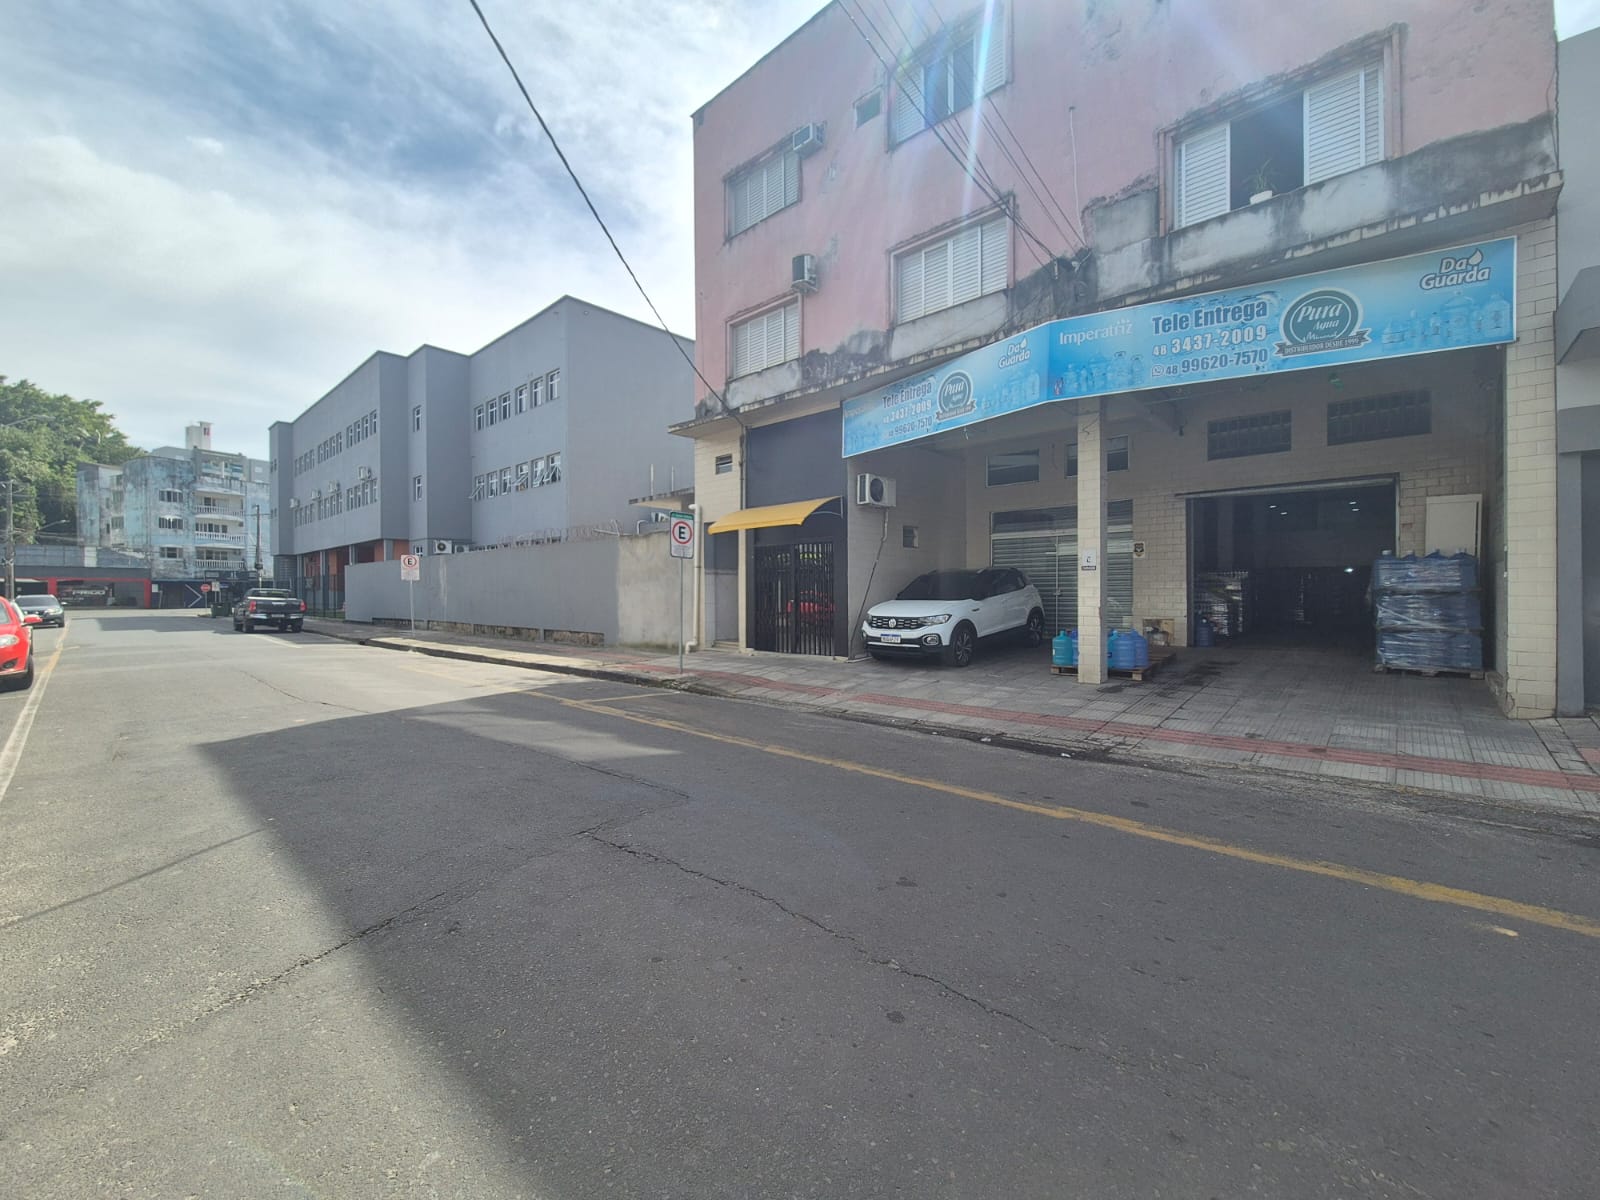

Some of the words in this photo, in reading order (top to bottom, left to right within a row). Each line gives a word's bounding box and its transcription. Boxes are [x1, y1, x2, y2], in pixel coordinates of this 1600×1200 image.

[1439, 256, 1468, 274] Da
[1419, 266, 1491, 291] Guarda
[1151, 315, 1191, 336] Tele
[1193, 299, 1268, 329] Entrega
[1296, 301, 1343, 325] Pura
[1059, 319, 1133, 346] Imperatriz
[1152, 344, 1168, 357] 48
[1170, 324, 1268, 355] 3437-2009
[998, 348, 1031, 369] Guarda
[1007, 343, 1021, 357] Da
[1165, 364, 1178, 376] 48
[1180, 348, 1269, 374] 99620-7570
[882, 393, 900, 409] Tele
[900, 381, 932, 403] Entrega
[678, 525, 687, 540] E
